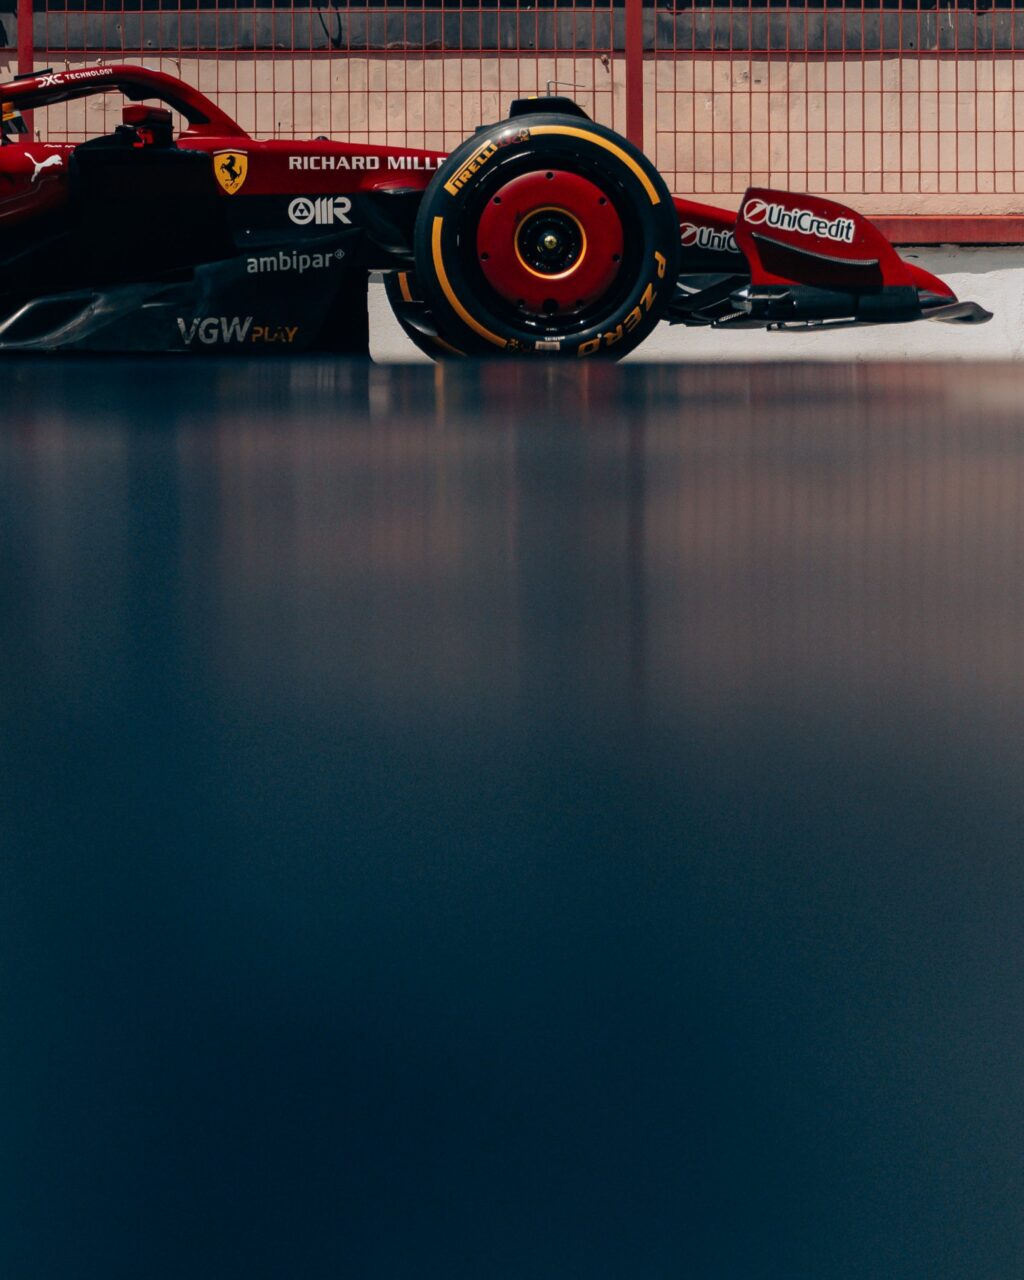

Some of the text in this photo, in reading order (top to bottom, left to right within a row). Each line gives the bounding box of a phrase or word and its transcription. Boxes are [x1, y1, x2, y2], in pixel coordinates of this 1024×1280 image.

[35, 68, 113, 88] DXC TECHNOLOGY
[288, 155, 380, 170] RICHARD
[443, 139, 498, 196] PIRELLI
[766, 204, 854, 243] UniCredit
[246, 250, 334, 273] ambipar
[177, 316, 298, 345] VGW PLAY
